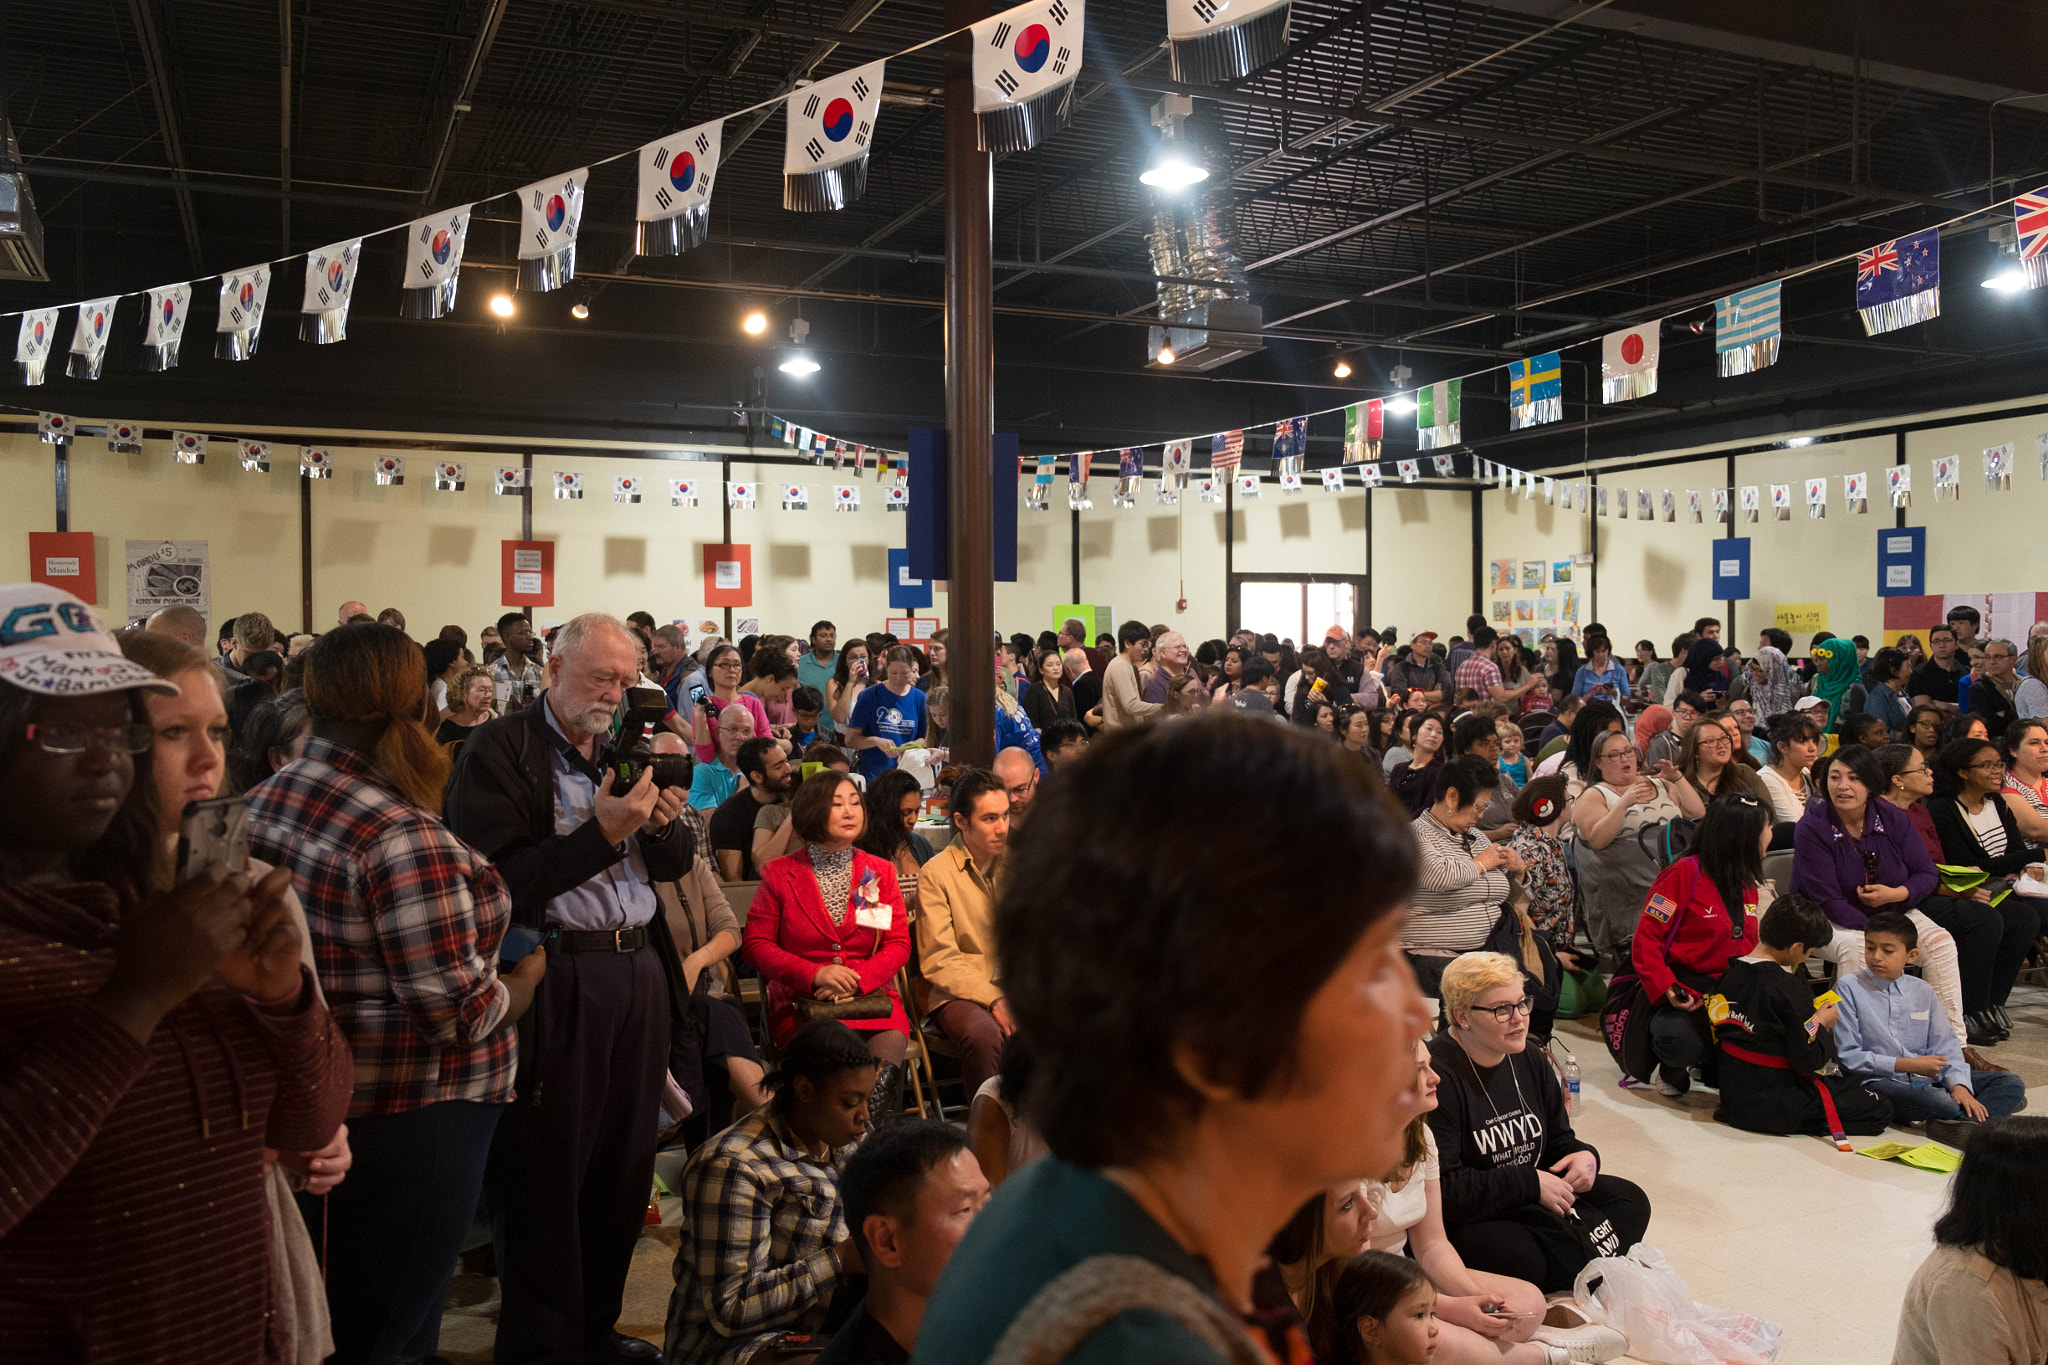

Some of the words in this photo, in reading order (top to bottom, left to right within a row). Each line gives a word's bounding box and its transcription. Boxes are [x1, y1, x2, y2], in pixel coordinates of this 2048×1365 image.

[126, 552, 161, 573] MANDU
[160, 547, 172, 557] $5
[29, 655, 94, 677] Mark
[55, 677, 109, 693] Bam
[1612, 1008, 1630, 1051] adidas
[1472, 1113, 1543, 1155] WWYD
[1491, 1149, 1512, 1164] WHAT
[1513, 1142, 1536, 1156] WOULD
